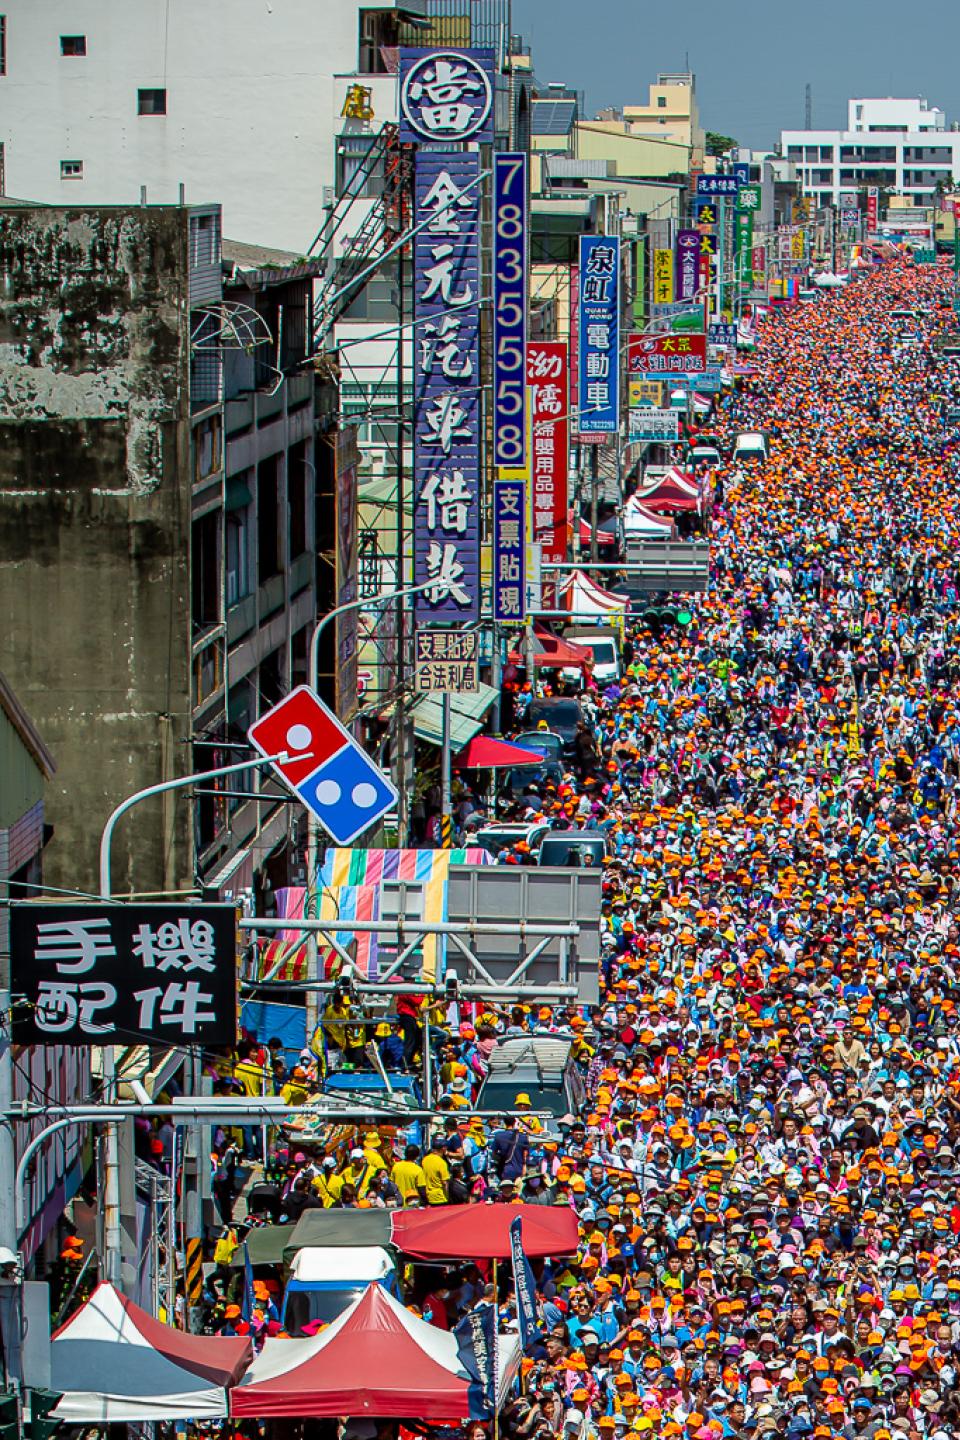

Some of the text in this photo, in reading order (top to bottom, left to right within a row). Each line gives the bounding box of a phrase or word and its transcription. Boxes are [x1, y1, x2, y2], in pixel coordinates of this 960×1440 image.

[411, 61, 480, 130] 當
[740, 190, 757, 208] 藥
[497, 160, 522, 459] 7835558
[418, 171, 475, 605] 金元汽車借款
[587, 325, 610, 407] 電動車
[632, 356, 704, 371] 火雞肉飯
[499, 488, 520, 614] 支票貼現
[418, 633, 475, 660] 支票貼現
[419, 664, 475, 690] 合法利息
[34, 918, 216, 975] 手機
[34, 981, 216, 1034] 配件
